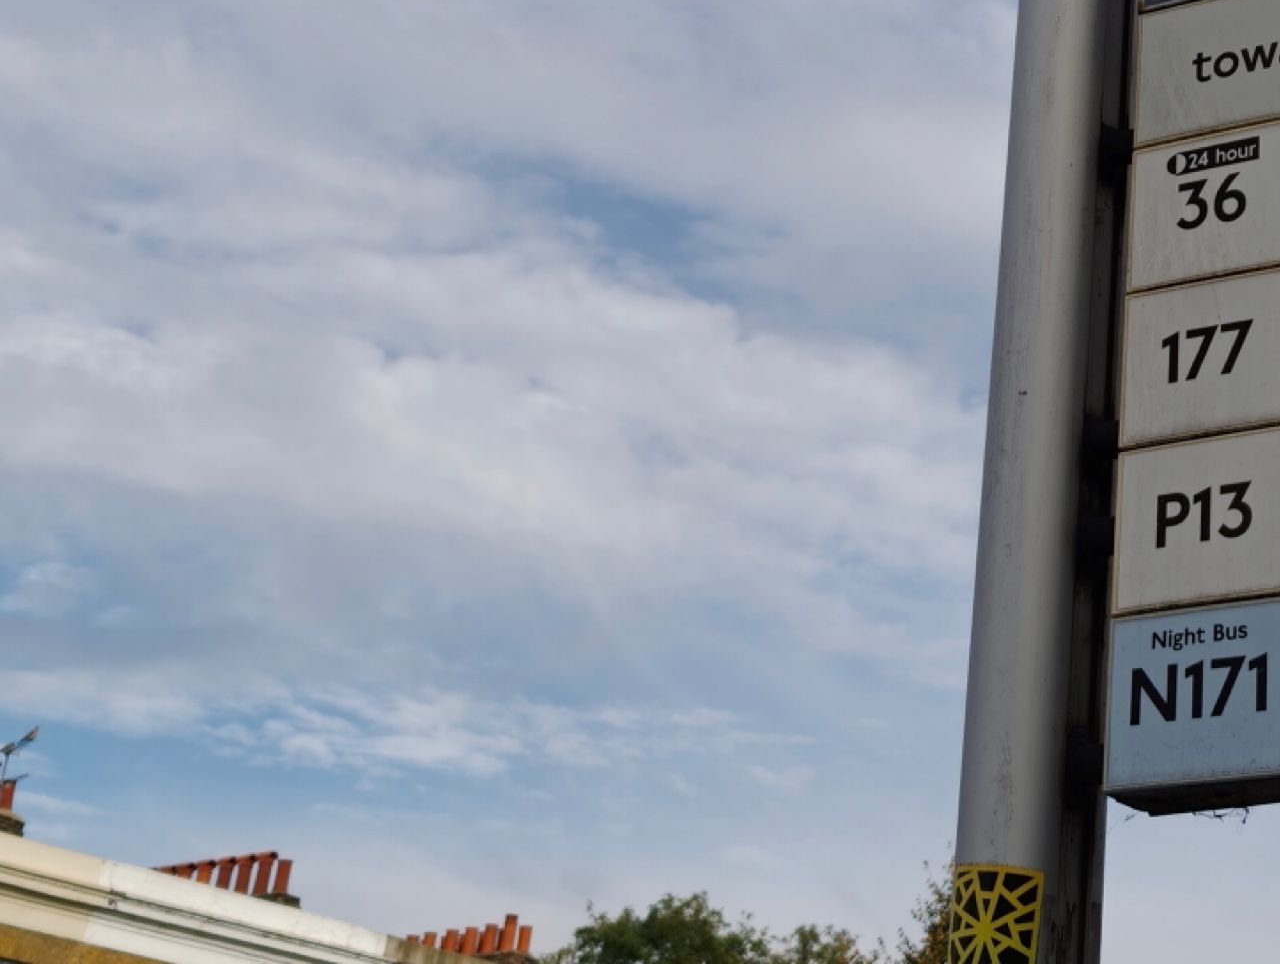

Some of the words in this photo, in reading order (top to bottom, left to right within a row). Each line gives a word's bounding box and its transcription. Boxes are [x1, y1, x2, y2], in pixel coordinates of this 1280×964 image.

[1188, 150, 1208, 169] 24
[1215, 143, 1256, 164] hour
[1177, 173, 1247, 230] 36
[1161, 319, 1254, 383] 177
[1155, 481, 1253, 548] P13
[1152, 628, 1205, 650] Night
[1213, 623, 1247, 642] Bus
[1129, 653, 1268, 726] N171
